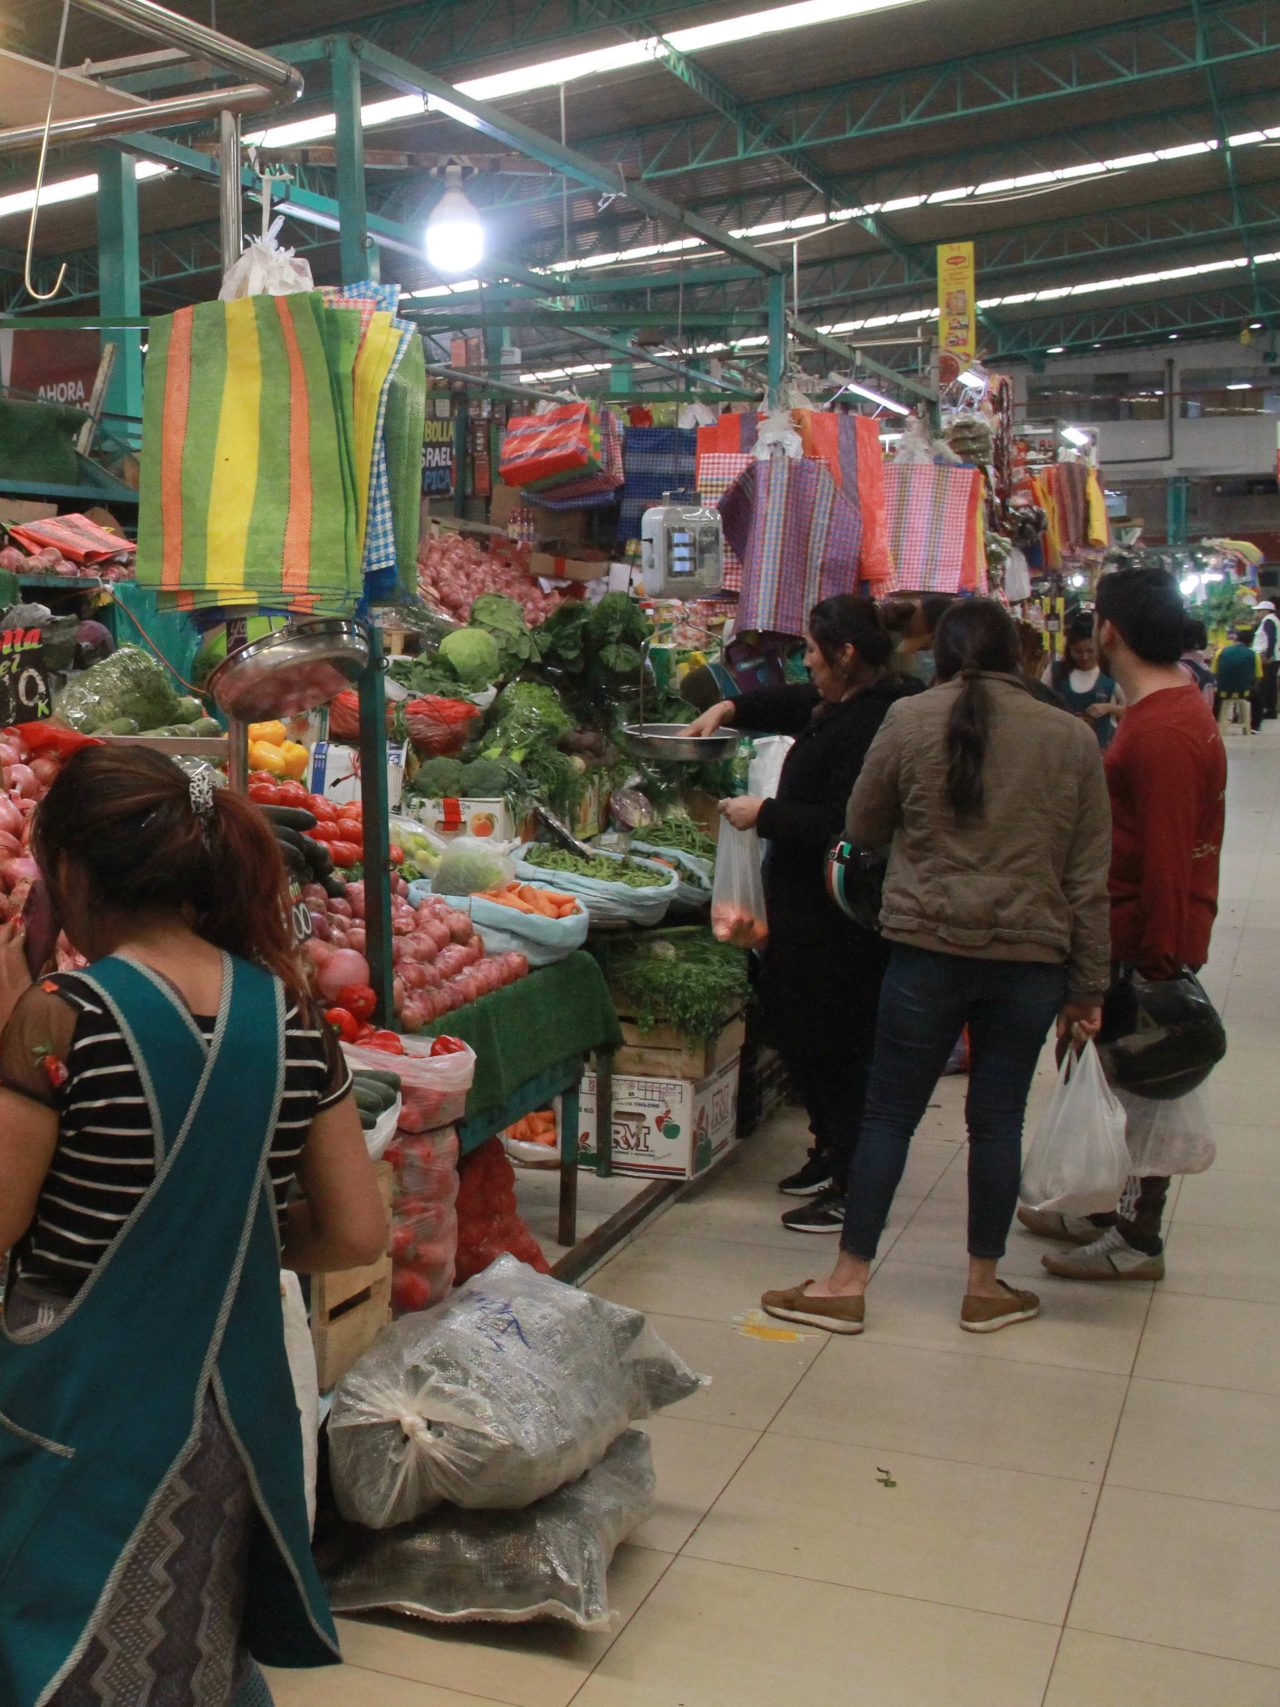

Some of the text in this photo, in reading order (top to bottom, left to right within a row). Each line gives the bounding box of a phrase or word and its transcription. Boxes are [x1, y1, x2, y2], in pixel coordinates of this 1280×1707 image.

[38, 380, 85, 404] AHORA
[425, 420, 453, 442] BOLLA
[421, 447, 452, 467] SRAEL
